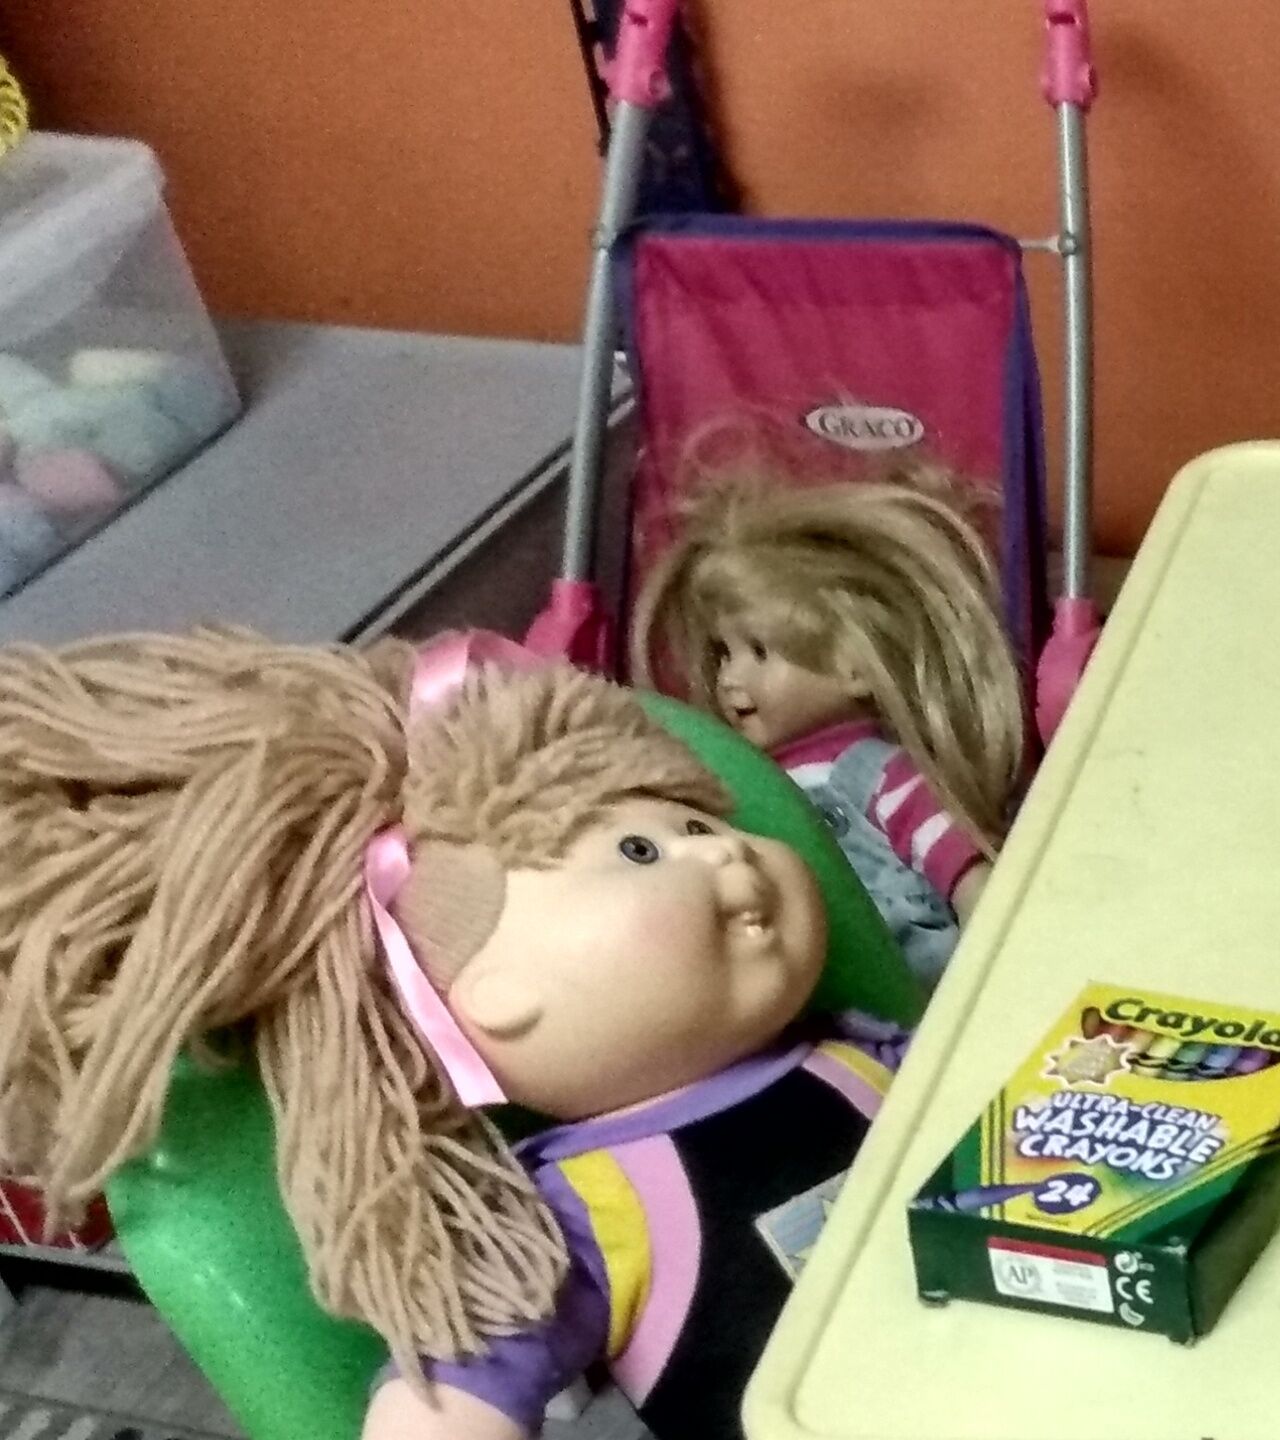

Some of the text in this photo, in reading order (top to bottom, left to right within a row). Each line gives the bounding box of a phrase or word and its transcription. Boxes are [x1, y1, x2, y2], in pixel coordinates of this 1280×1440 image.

[817, 412, 916, 438] GRACO
[1052, 1092, 1220, 1132] ULTRA-CLEAN
[1014, 1108, 1221, 1164] WASHABLE
[1020, 1134, 1181, 1180] CRAYONS
[1037, 1180, 1094, 1206] 24
